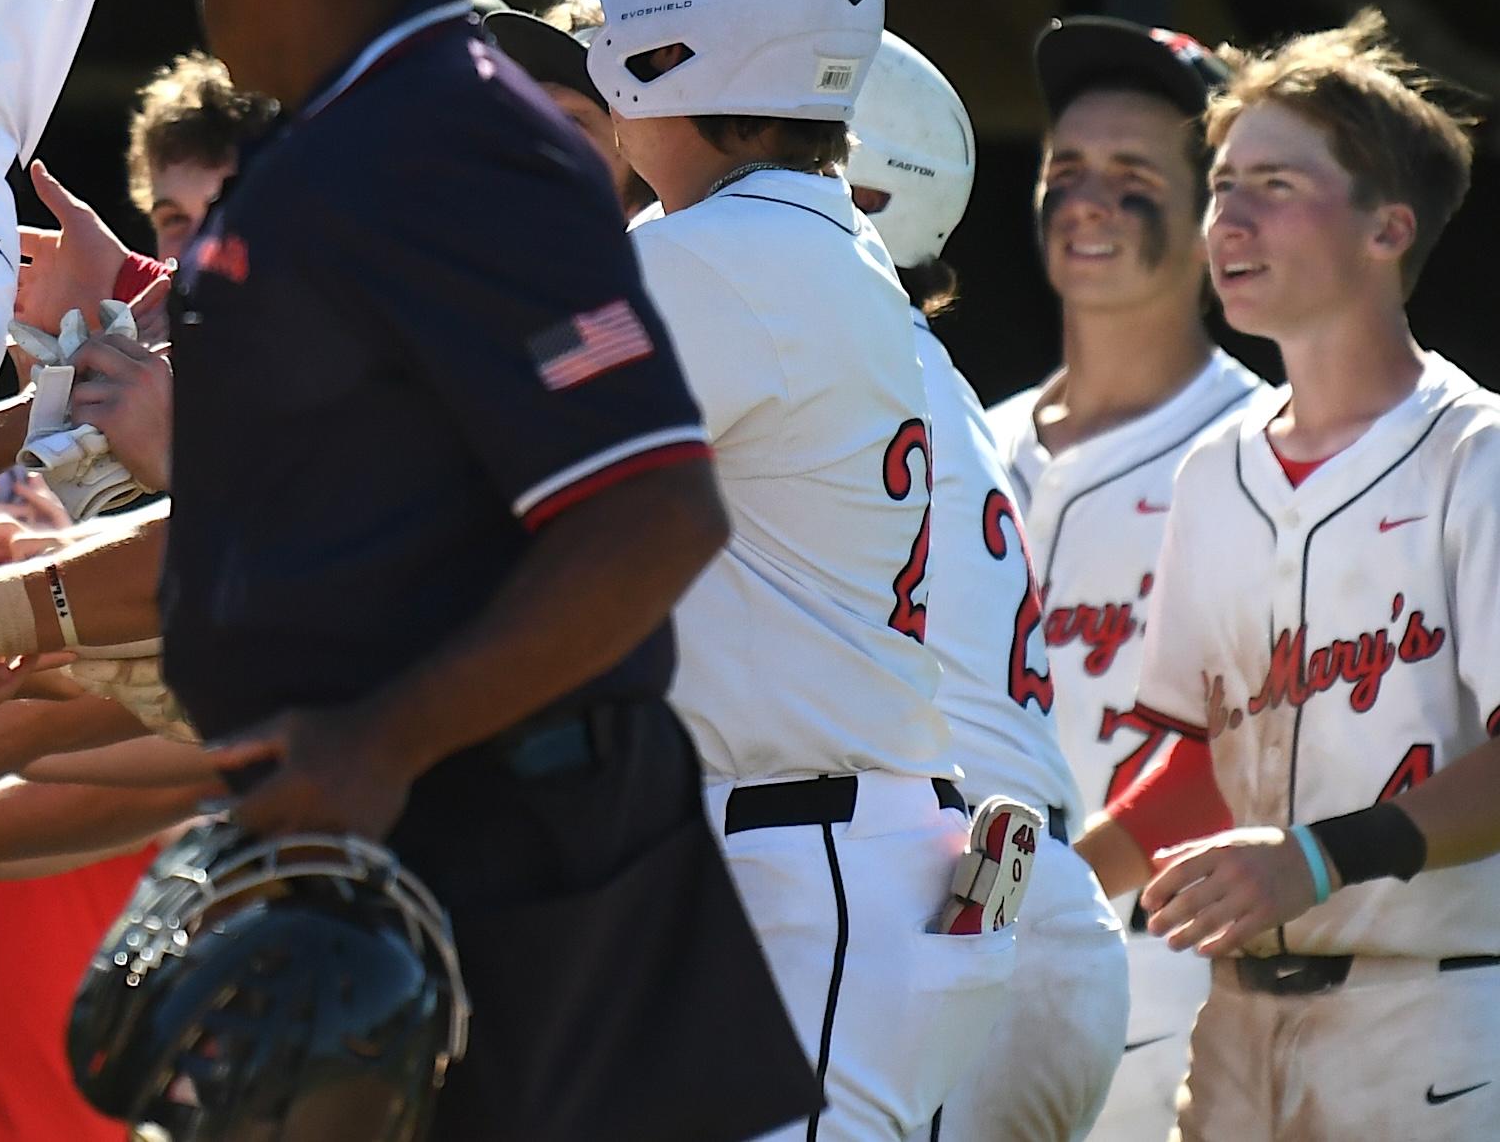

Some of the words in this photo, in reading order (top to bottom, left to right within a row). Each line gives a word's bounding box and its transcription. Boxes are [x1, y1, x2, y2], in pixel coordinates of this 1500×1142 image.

[621, 0, 692, 20] EVOSHIELD
[887, 158, 935, 177] EASTON
[1248, 591, 1446, 713] Mary's
